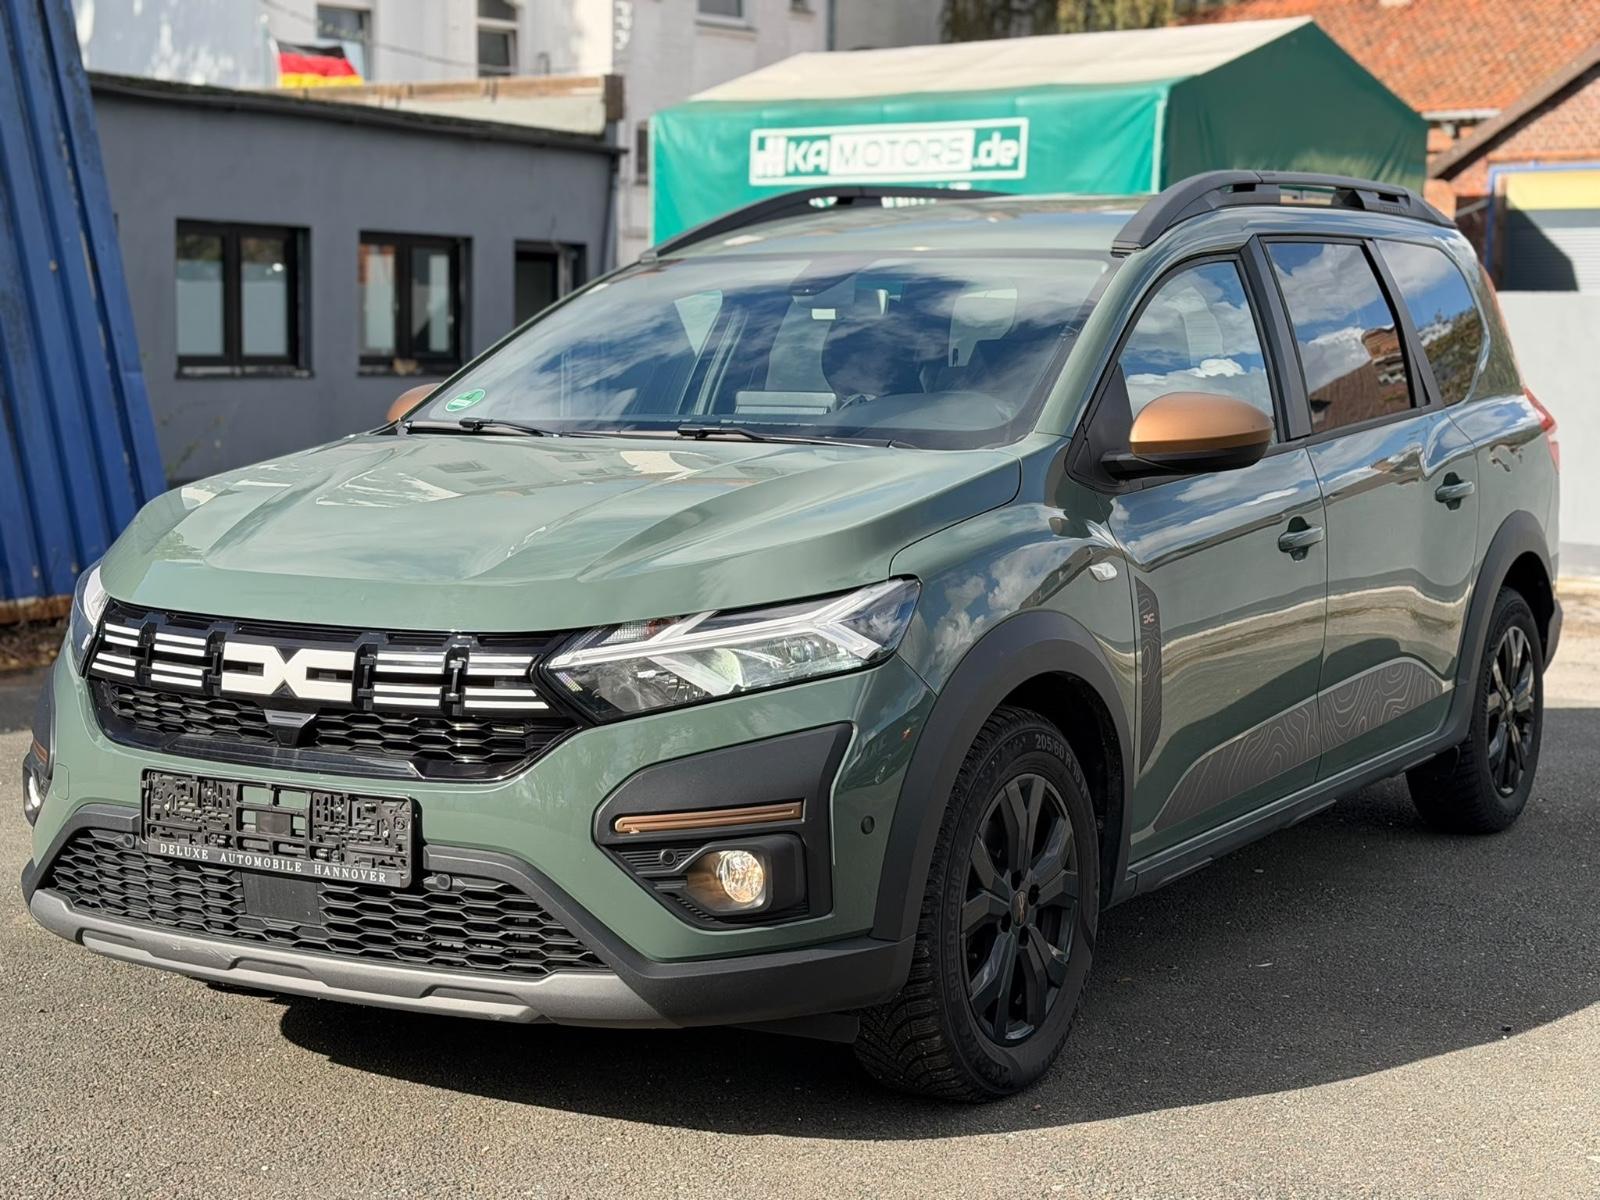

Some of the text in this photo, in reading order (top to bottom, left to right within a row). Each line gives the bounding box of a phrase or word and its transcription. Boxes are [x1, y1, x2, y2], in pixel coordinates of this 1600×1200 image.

[160, 843, 387, 883] DELUXE AUTOMOBILE HANNOVER
